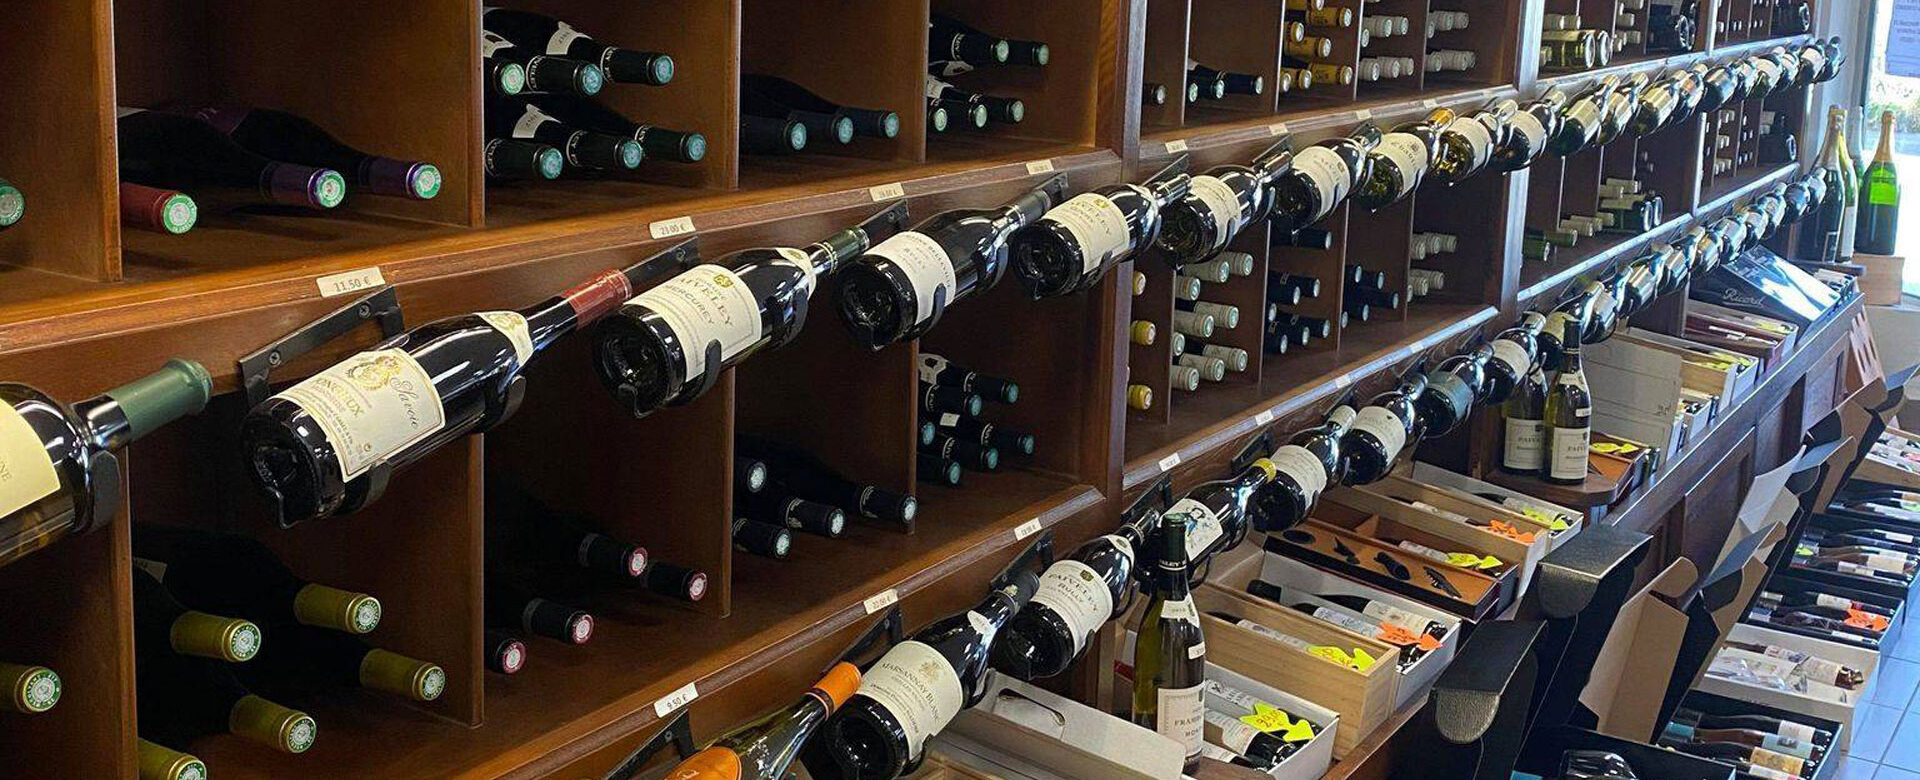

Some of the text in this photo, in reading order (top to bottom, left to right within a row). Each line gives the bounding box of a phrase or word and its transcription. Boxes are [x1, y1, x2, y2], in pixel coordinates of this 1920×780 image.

[333, 276, 371, 292] 11,50 €
[680, 278, 734, 327] AIVELEY
[881, 662, 928, 695] MARSANNAY
